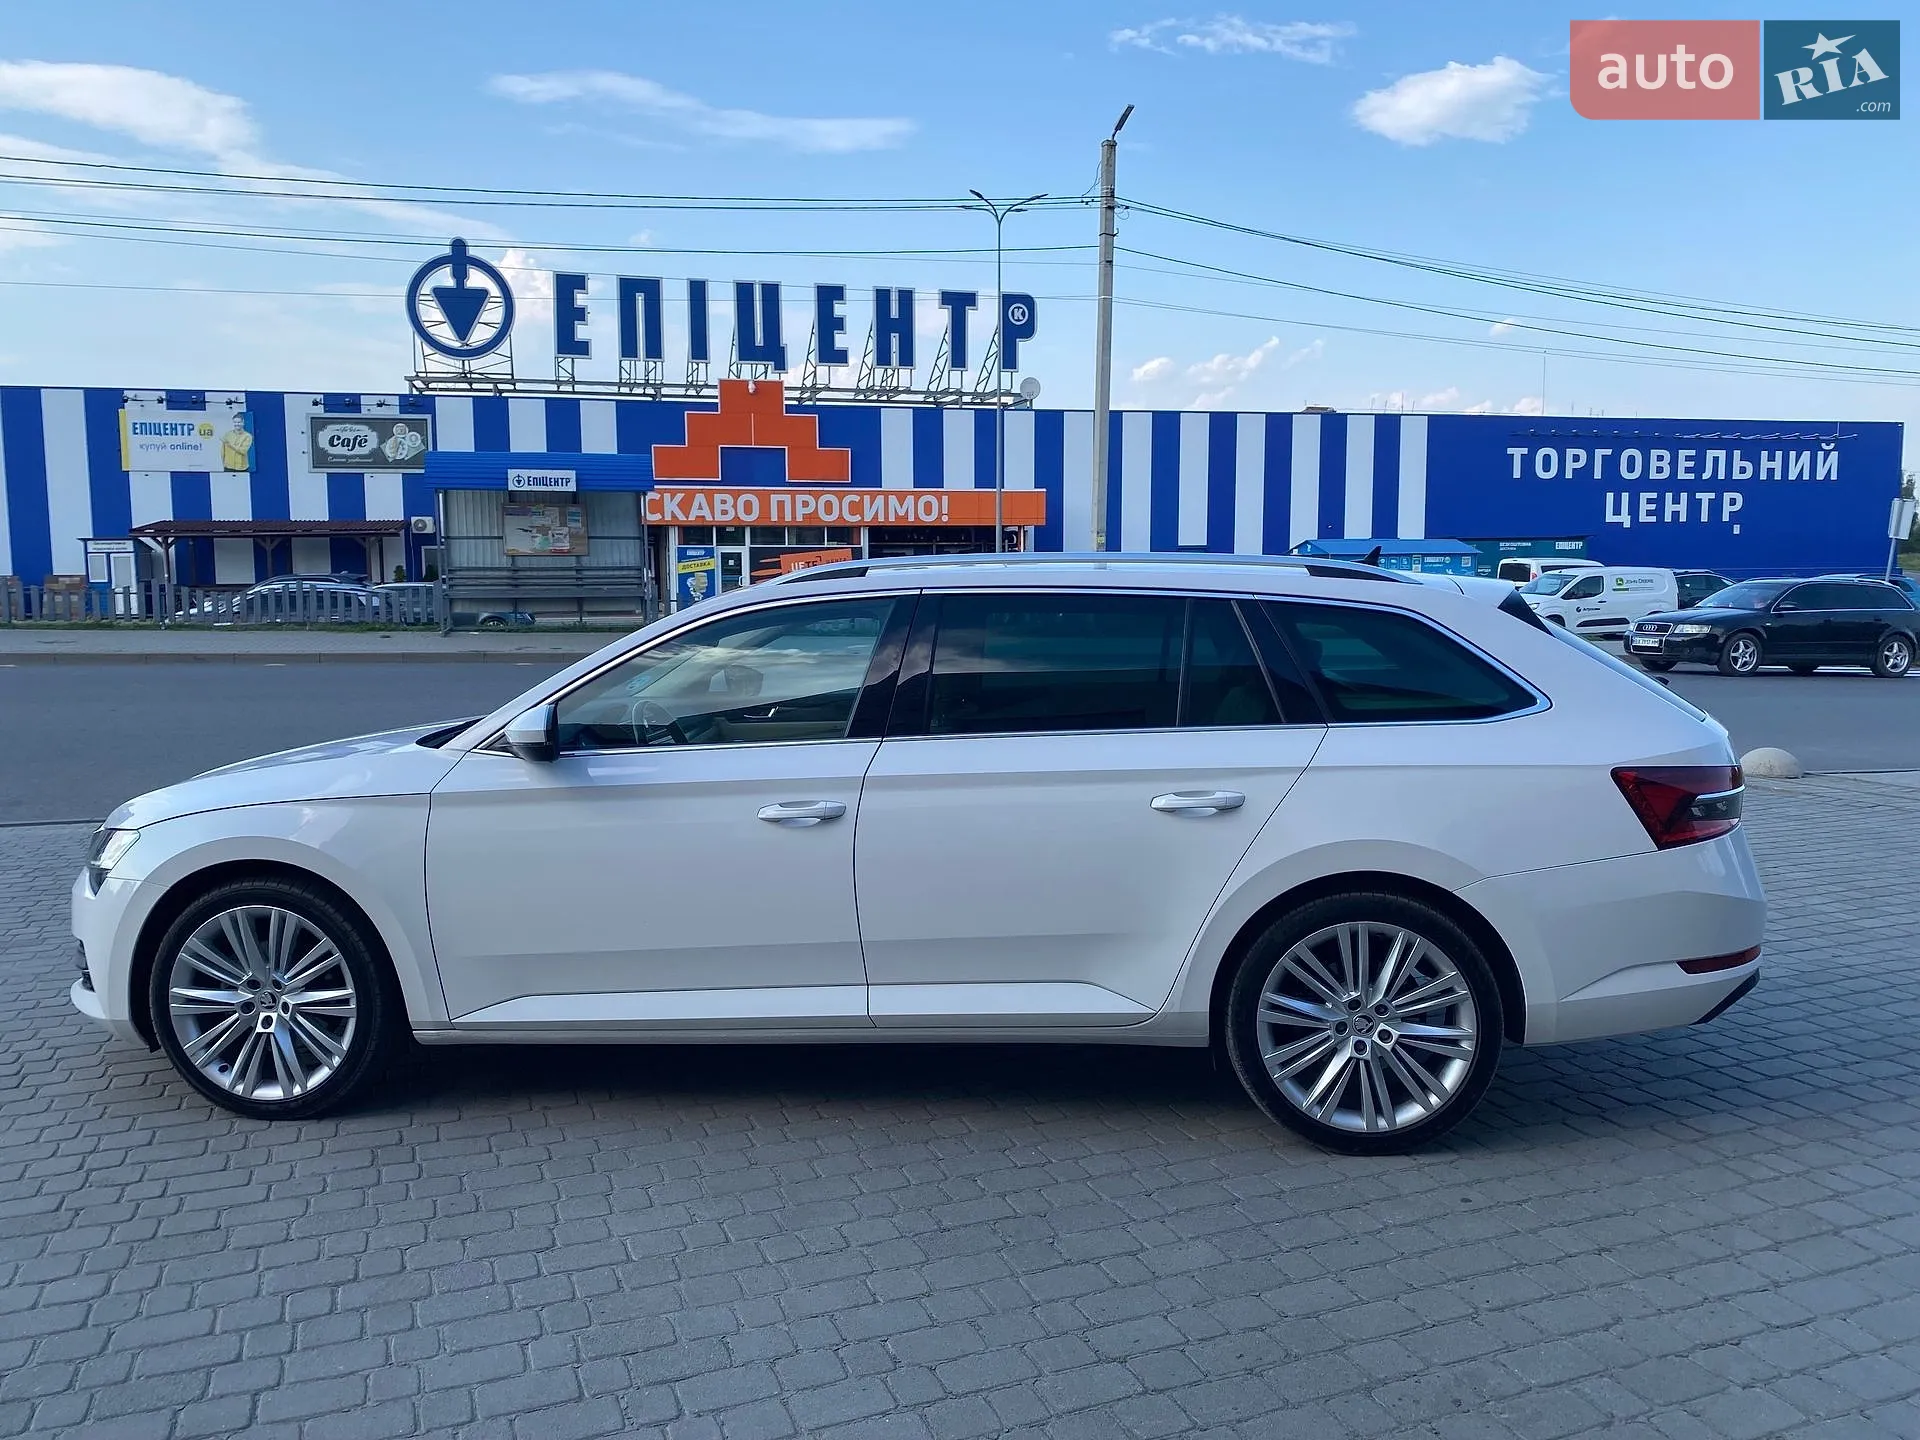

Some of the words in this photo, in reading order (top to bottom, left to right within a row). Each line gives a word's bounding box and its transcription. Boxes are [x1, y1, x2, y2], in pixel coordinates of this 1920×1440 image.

[554, 272, 1038, 374] ЕПІЦЕНТР
[131, 421, 195, 436] ЕПІЦЕНТР
[199, 427, 214, 437] ua
[169, 441, 203, 452] online!
[328, 434, 369, 451] Café
[1507, 442, 1839, 481] ТОРГОВЕЛЬНИЙ
[527, 475, 572, 487] ЕПІЦЕНТР
[769, 493, 949, 523] ПРОСИМО!
[1605, 492, 1744, 528] ЦЕНТР
